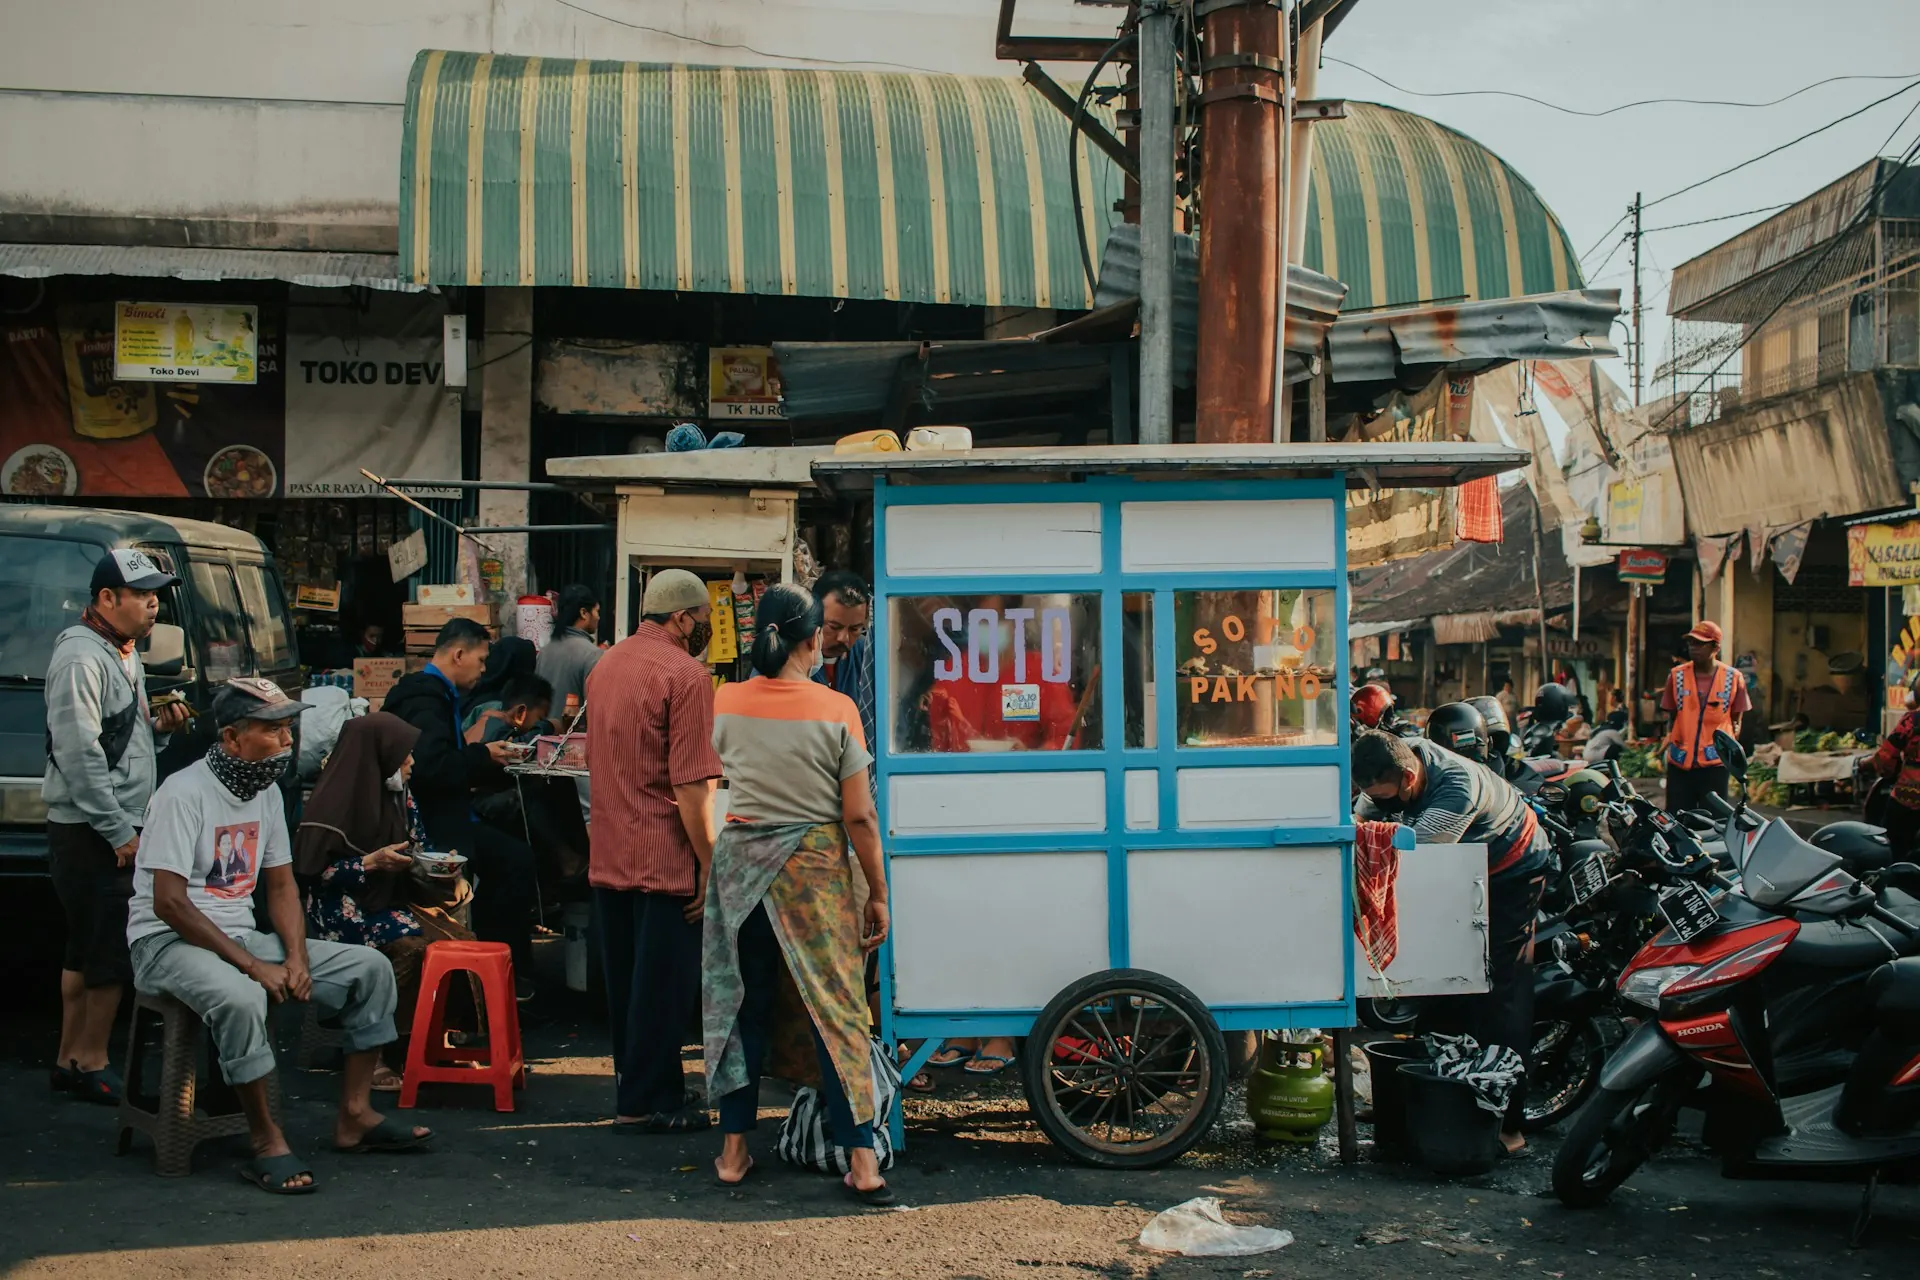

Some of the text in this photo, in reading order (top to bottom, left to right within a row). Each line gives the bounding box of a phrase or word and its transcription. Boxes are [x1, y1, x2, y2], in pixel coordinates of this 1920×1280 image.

[123, 305, 166, 319] Bimoli
[149, 367, 200, 376] Toko Devi
[300, 360, 442, 385] TOKO DEV
[726, 404, 744, 415] TK
[749, 405, 765, 415] HJ
[289, 483, 330, 493] PASAR
[333, 483, 366, 493] RAYA
[1193, 615, 1316, 655] SOTO
[932, 607, 1072, 684] SOTO
[1190, 672, 1321, 704] PAK NO
[1676, 885, 1714, 929] K 3164 CG
[1676, 1022, 1725, 1037] HONDA
